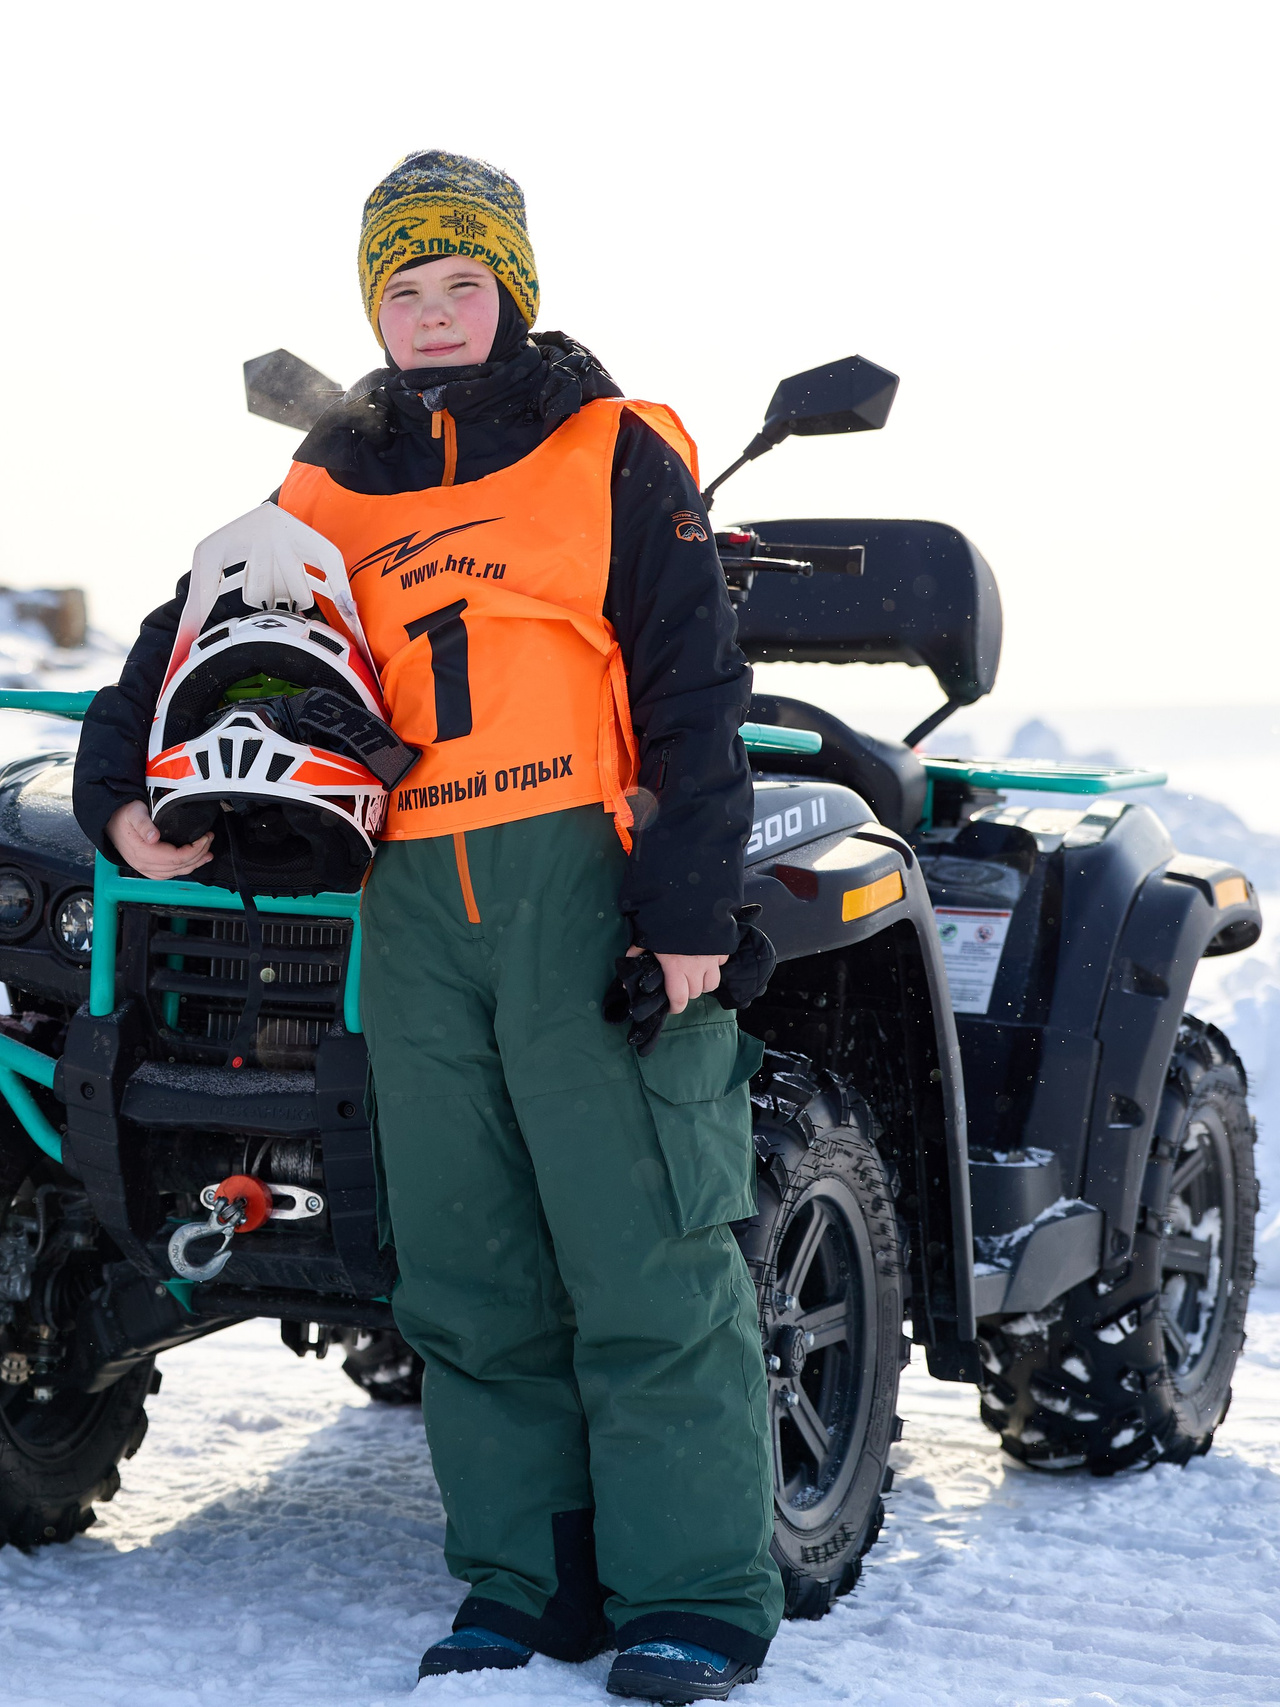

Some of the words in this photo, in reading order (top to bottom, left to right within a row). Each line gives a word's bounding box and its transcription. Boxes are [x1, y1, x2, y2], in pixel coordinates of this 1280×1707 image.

[400, 554, 506, 590] www.hft.ru
[403, 598, 473, 744] 1
[299, 692, 401, 757] EATT
[397, 771, 487, 812] АКТИВНЫЙ
[495, 755, 573, 792] ОТДЫХ
[811, 797, 827, 827] II
